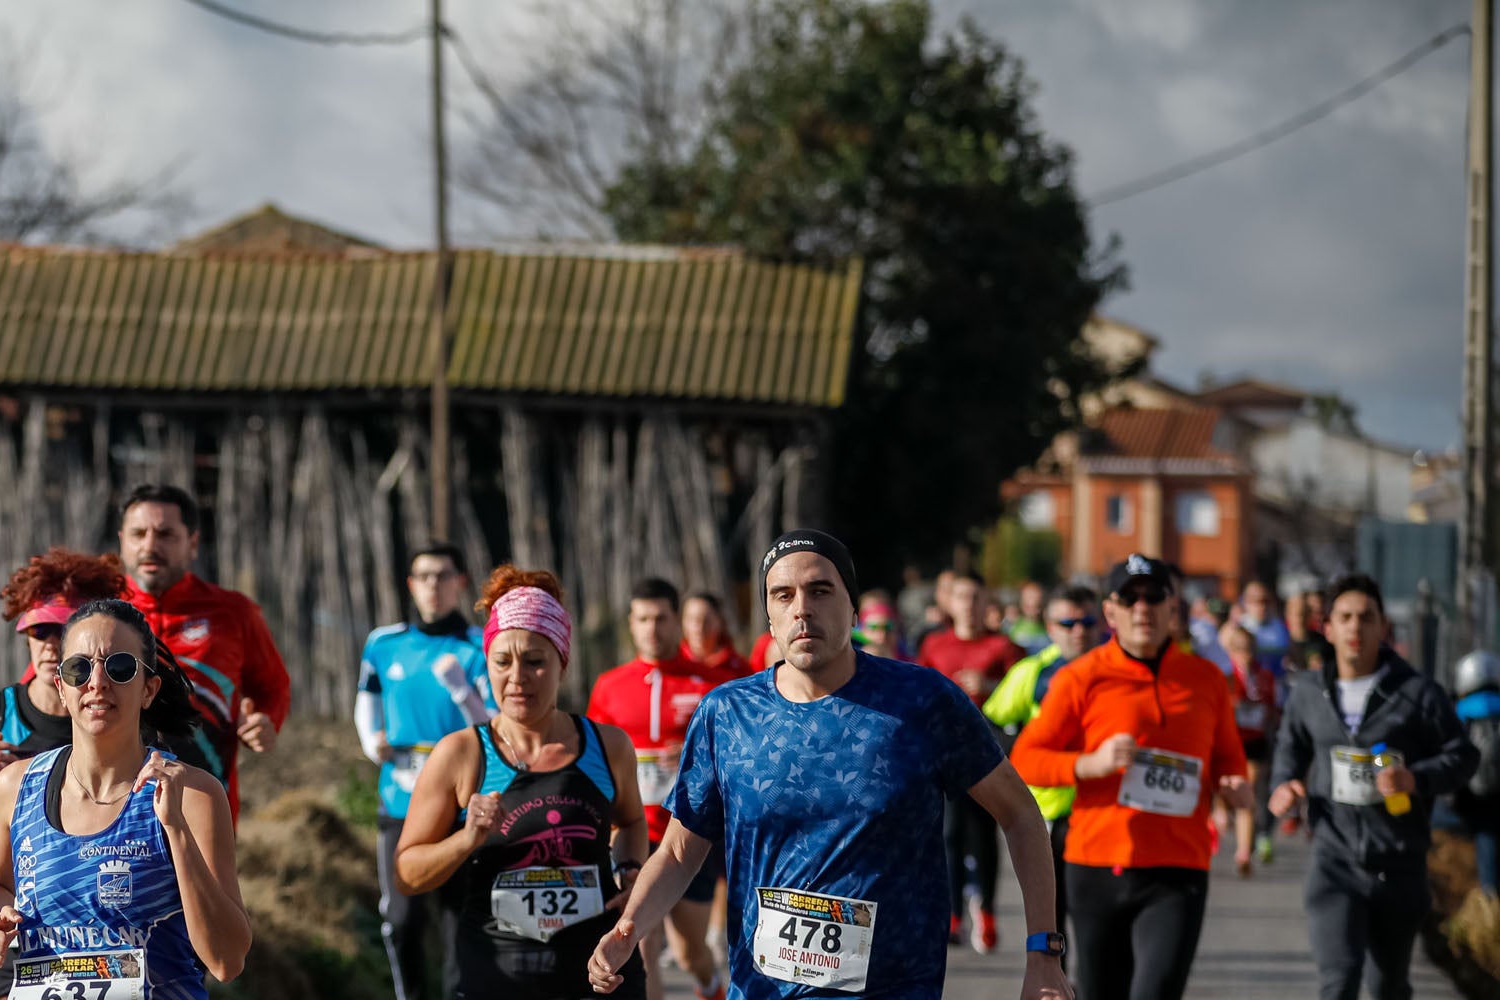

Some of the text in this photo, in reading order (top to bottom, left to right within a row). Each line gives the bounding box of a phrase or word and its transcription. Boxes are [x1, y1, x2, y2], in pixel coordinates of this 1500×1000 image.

[1144, 768, 1185, 794] 660
[79, 846, 152, 858] CONTINENTAL
[521, 889, 579, 917] 132
[789, 893, 829, 907] CARRERA
[789, 901, 829, 913] POPULAR
[538, 917, 565, 930] EMMA
[779, 917, 842, 953] 478
[20, 966, 32, 975] 26
[50, 957, 94, 968] CARRERA
[779, 946, 798, 963] JOSE
[800, 951, 841, 970] ANTONIO
